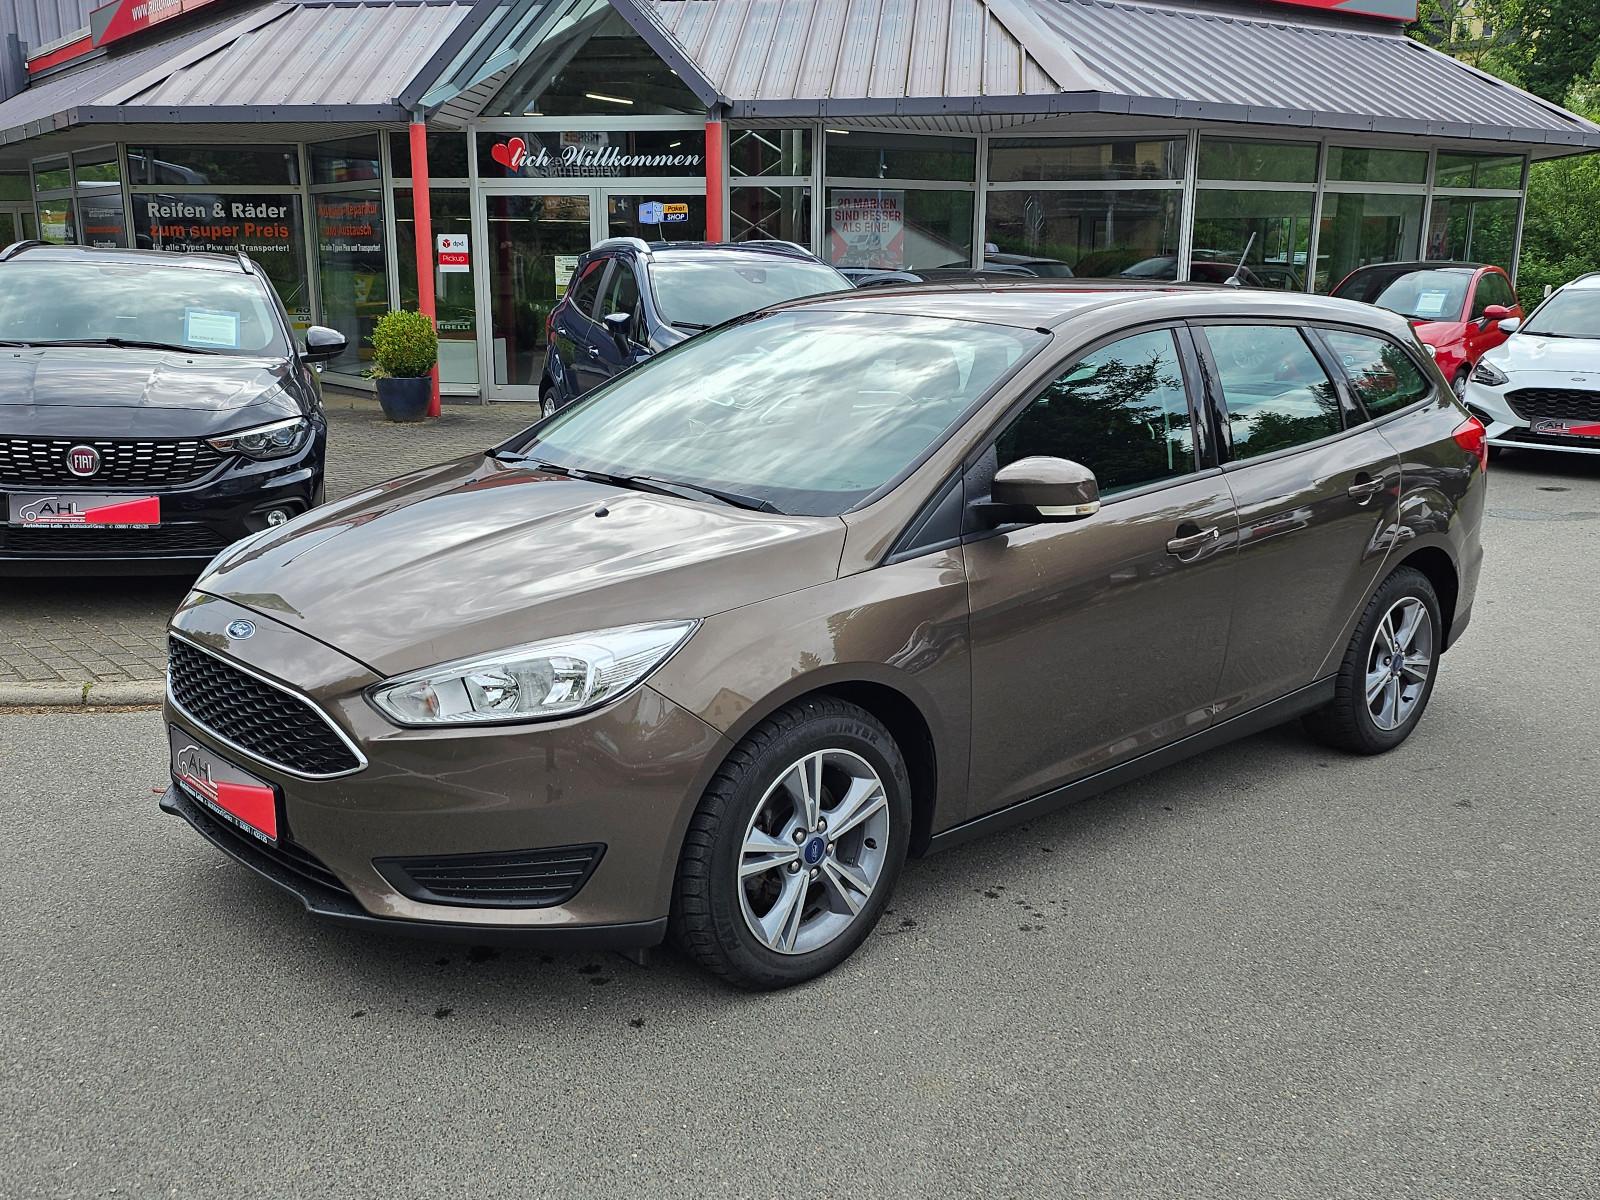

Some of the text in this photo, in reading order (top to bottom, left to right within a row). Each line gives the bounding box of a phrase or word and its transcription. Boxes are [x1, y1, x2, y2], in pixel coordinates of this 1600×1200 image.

[511, 147, 552, 167] lich
[562, 145, 704, 167] Willkommen
[147, 201, 287, 218] Reifen & Räder
[838, 198, 896, 209] 20 MARKEN
[835, 210, 901, 221] SIND BESSER
[149, 222, 289, 240] zum super Preis
[842, 222, 890, 233] ALS EINE!
[181, 243, 205, 252] Typen
[206, 243, 223, 251] Pkw
[224, 243, 239, 251] und
[241, 243, 290, 252] Transporter!
[442, 254, 465, 262] Pickup
[1547, 422, 1570, 430] AHL
[74, 454, 94, 469] FIAT
[39, 502, 85, 515] AHL
[188, 752, 217, 789] AHL
